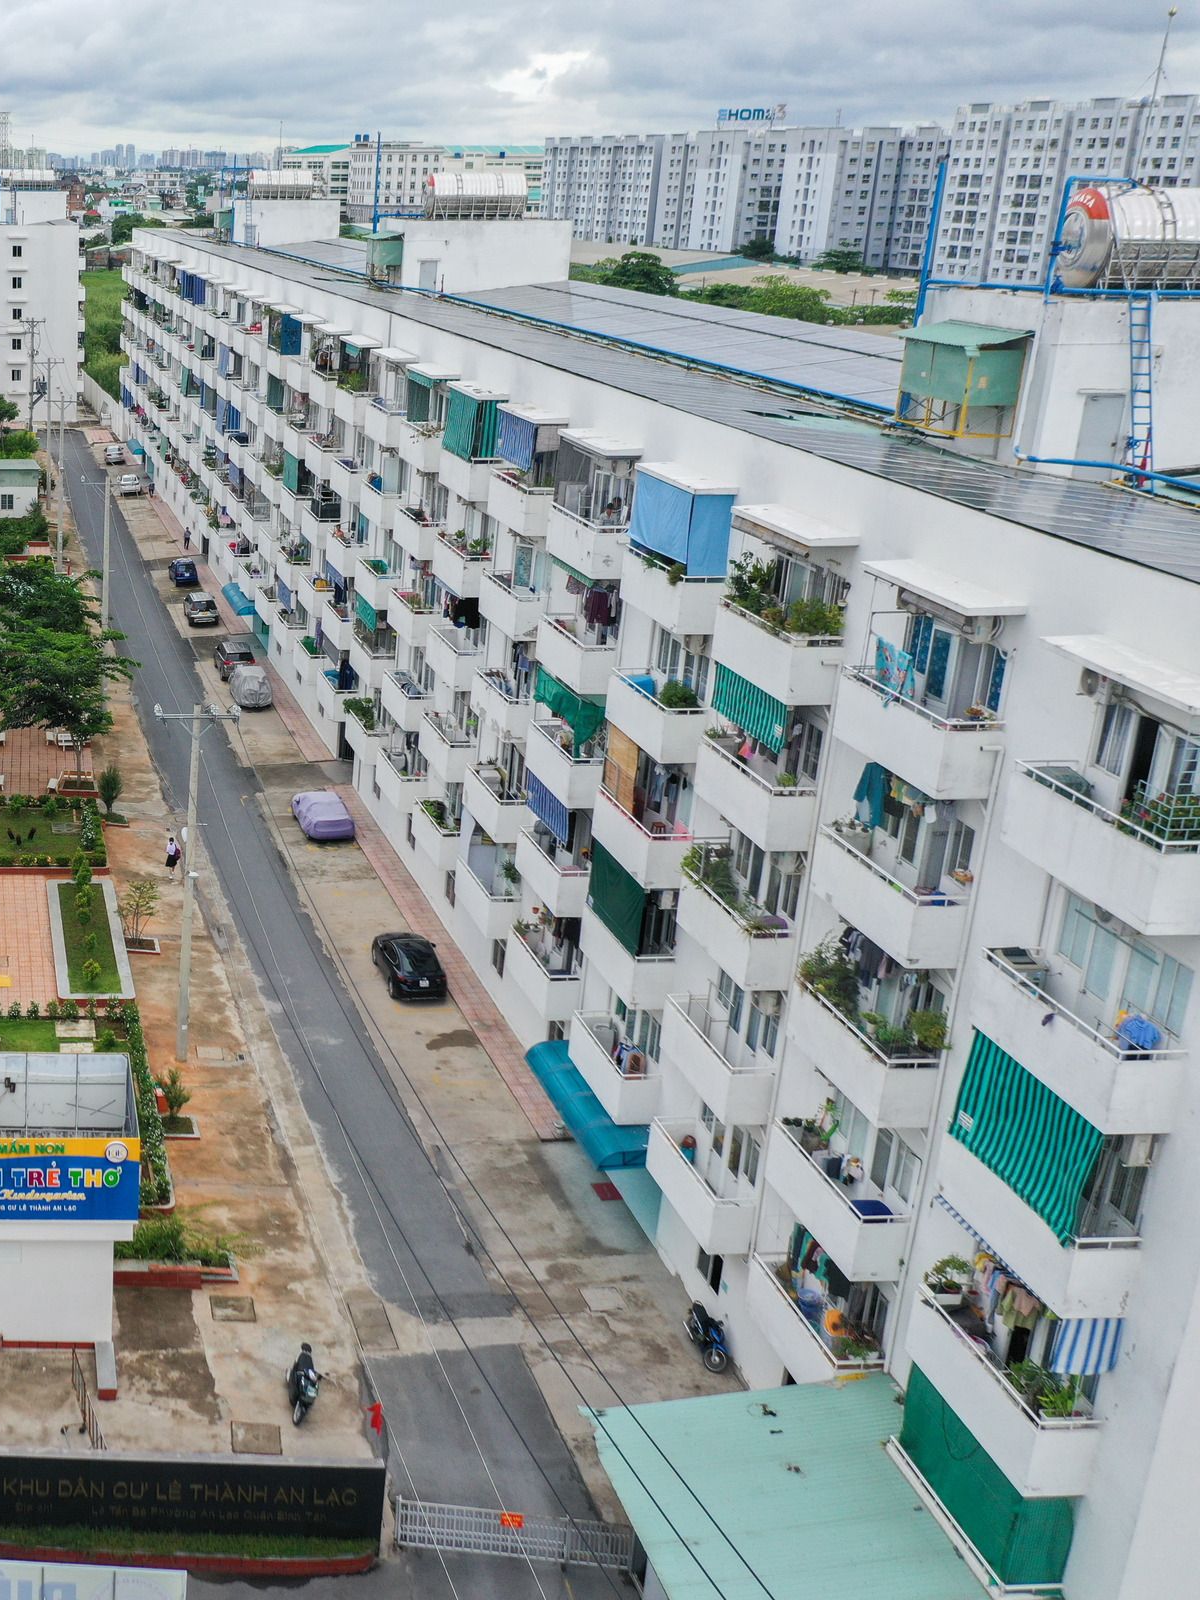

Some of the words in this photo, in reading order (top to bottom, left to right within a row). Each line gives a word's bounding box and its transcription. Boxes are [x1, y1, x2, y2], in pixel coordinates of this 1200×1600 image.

[34, 1142, 65, 1154] NON
[10, 1160, 62, 1188] TRẺ
[68, 1165, 123, 1188] THƠ
[3, 1477, 50, 1496] KHU
[58, 1476, 105, 1498] DÂN
[112, 1480, 150, 1499] CƯ
[157, 1479, 182, 1500] LÊ
[189, 1481, 268, 1504] THÀNH
[274, 1486, 305, 1505] AN
[313, 1487, 358, 1507] LẠC
